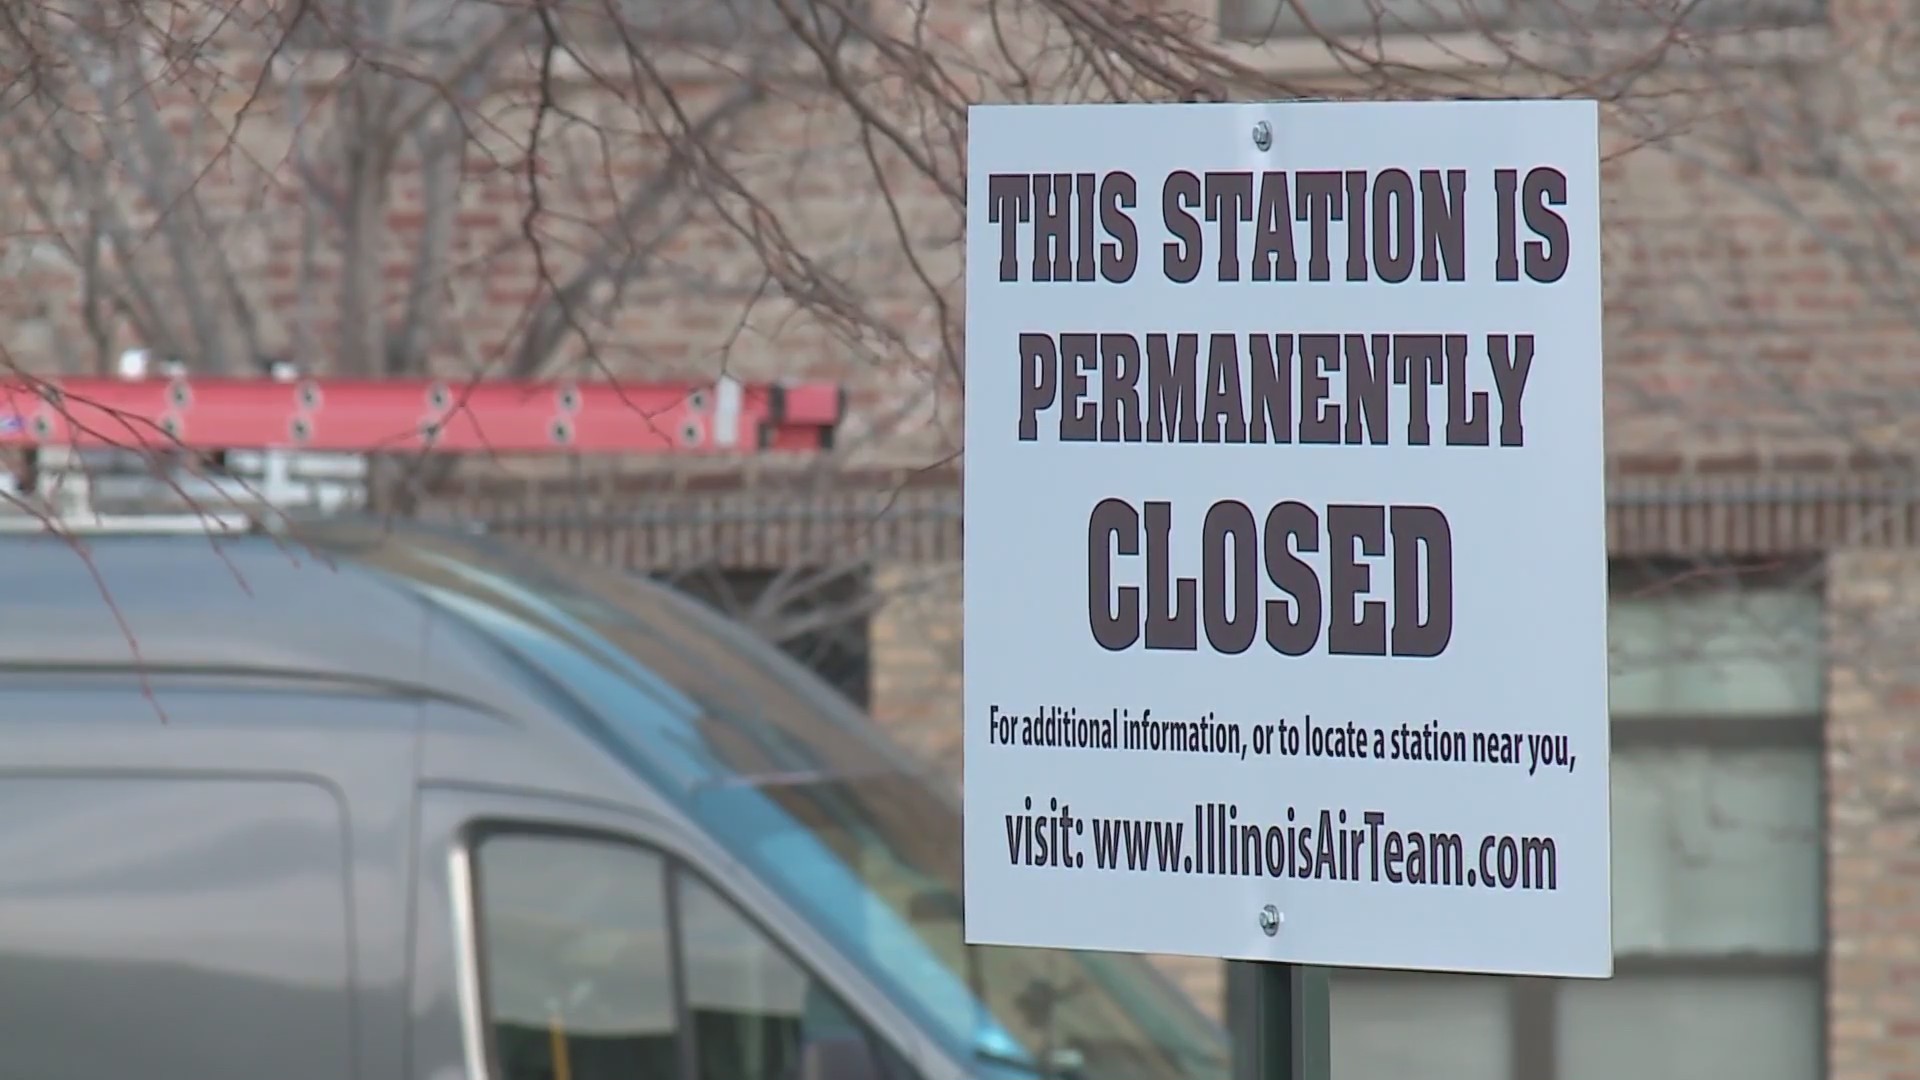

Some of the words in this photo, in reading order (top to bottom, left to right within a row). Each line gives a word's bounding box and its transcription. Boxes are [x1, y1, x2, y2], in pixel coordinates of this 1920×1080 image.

[988, 170, 1139, 285] THIS
[1161, 167, 1467, 285] STATION
[1493, 166, 1570, 284] IS
[1018, 332, 1535, 448] PERMANENTLY
[1087, 497, 1453, 659] CLOSED
[989, 704, 1019, 746] For
[1021, 705, 1118, 750] additional
[1123, 707, 1248, 761] information,
[1252, 724, 1275, 755] or
[1277, 718, 1300, 756] to
[1305, 714, 1368, 759] locate
[1373, 728, 1386, 760] a
[1390, 719, 1467, 763] station
[1472, 732, 1524, 764] near
[1527, 734, 1576, 777] you,
[1004, 795, 1084, 869] visit:
[1091, 802, 1557, 891] www.IllinoisAirTeam.com
